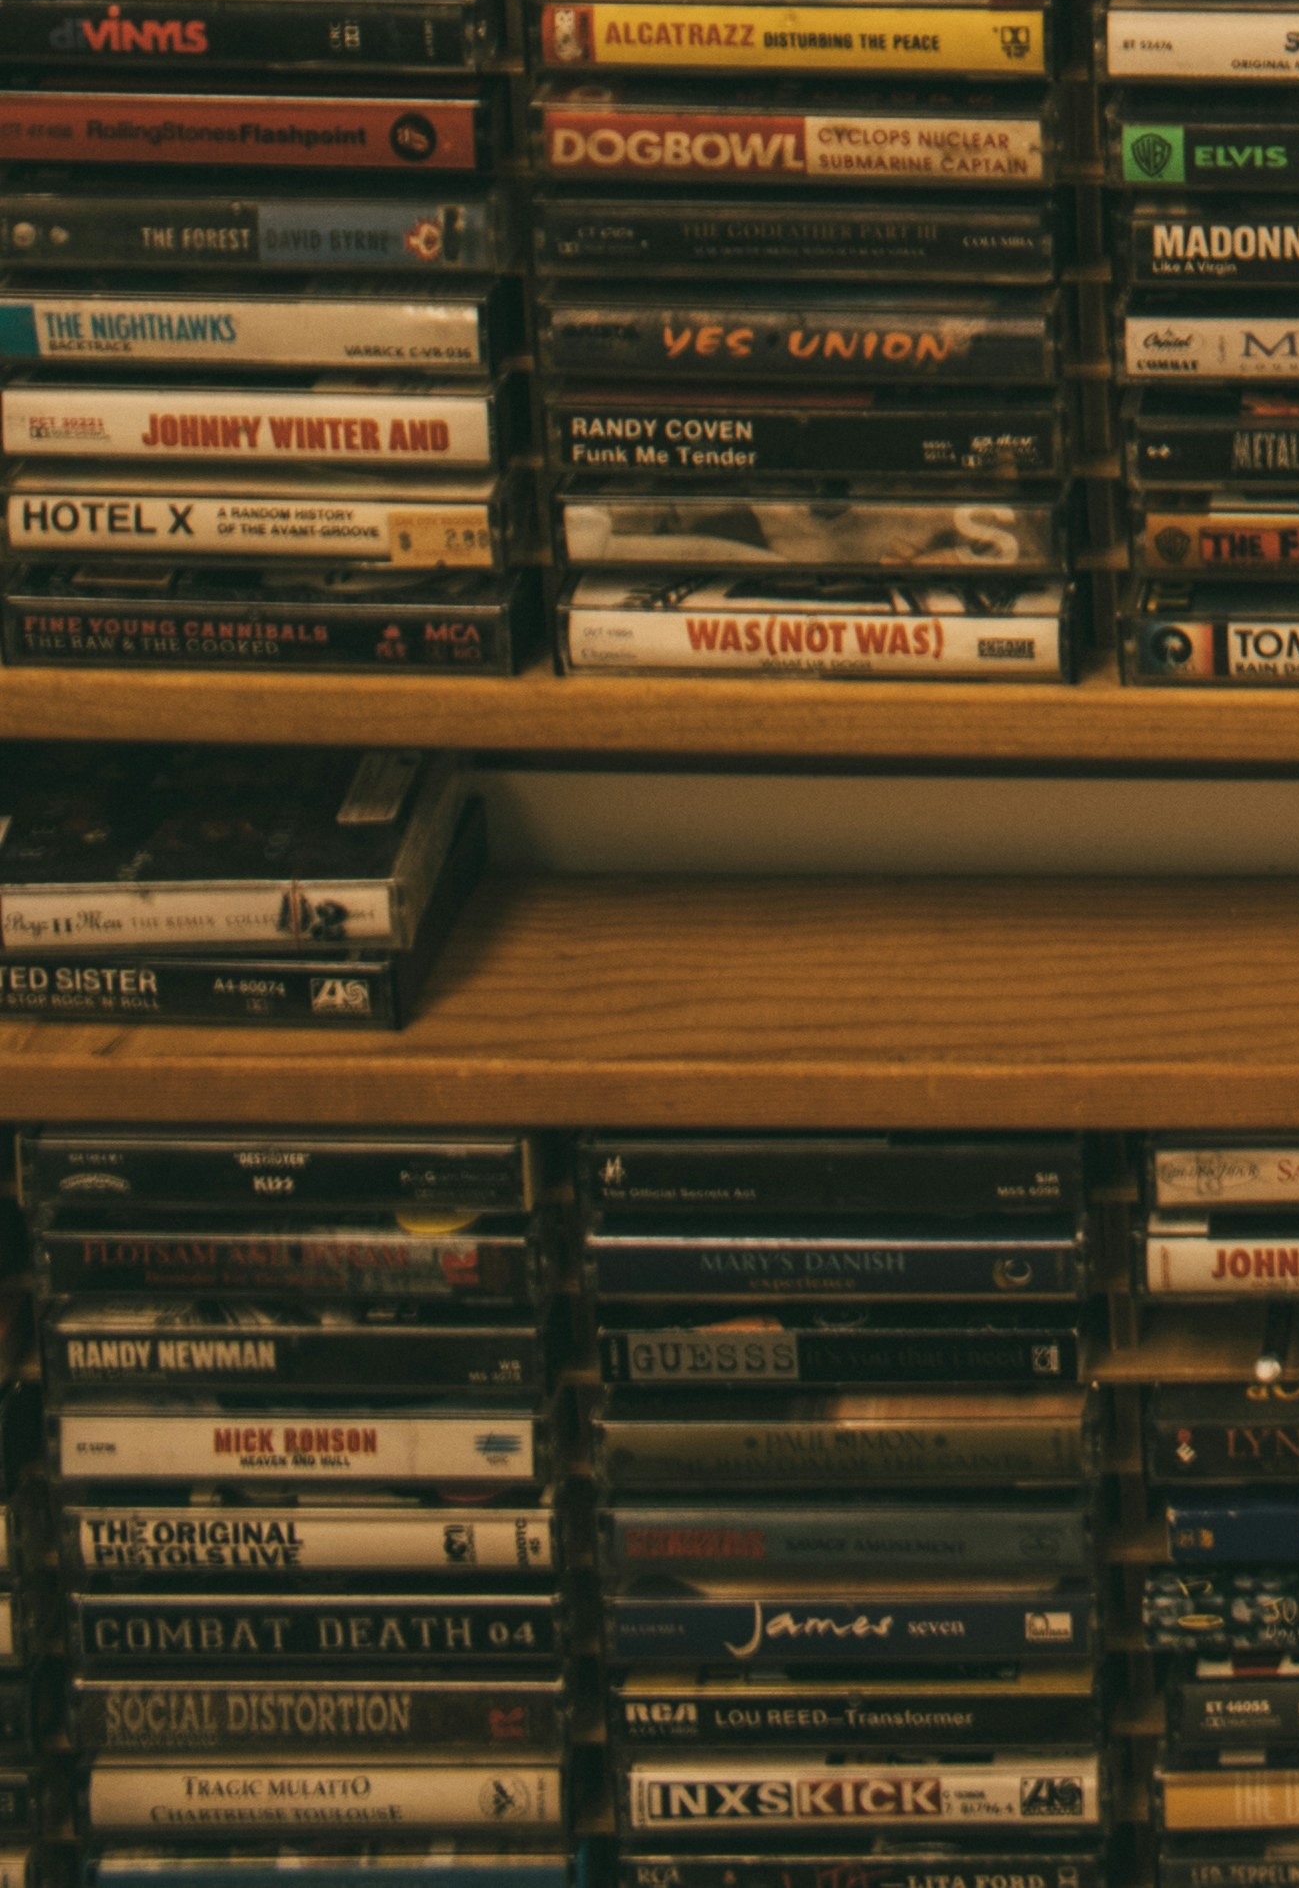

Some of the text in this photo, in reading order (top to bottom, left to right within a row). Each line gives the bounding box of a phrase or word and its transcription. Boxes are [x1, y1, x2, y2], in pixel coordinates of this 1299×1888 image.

[1194, 147, 1288, 169] ELVIS
[142, 415, 450, 451] JOHNNY WINTER AND
[571, 418, 753, 444] RANDY COVEN
[572, 444, 758, 466] Funk Me Tender
[96, 1617, 536, 1650] COMBAT DEATH 04
